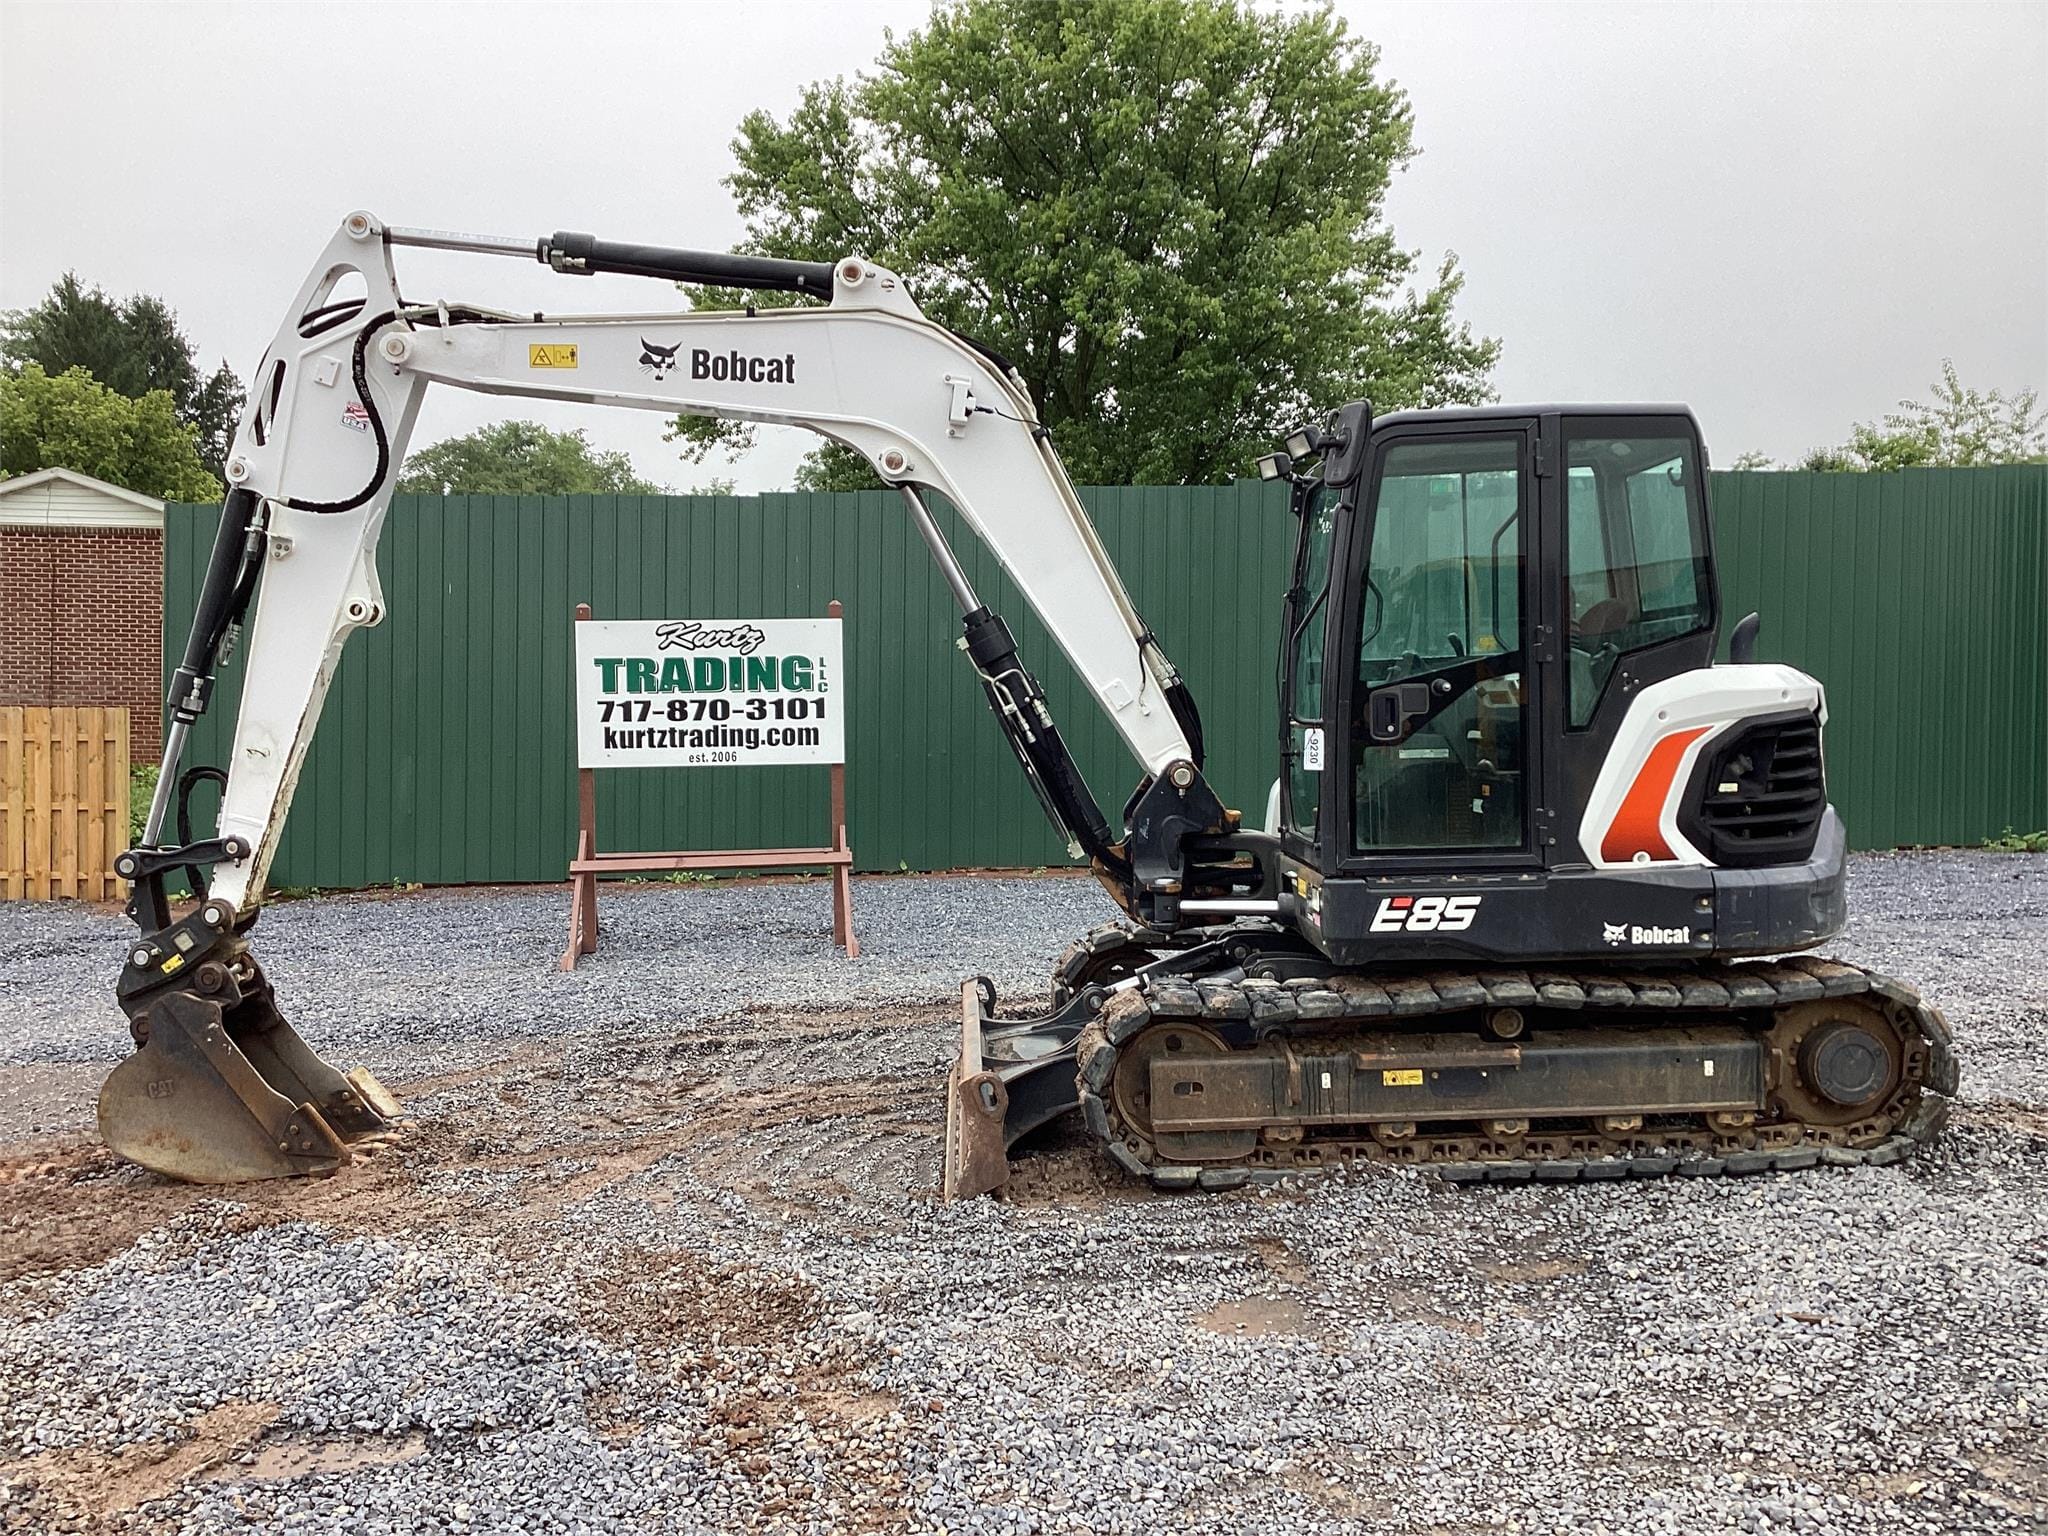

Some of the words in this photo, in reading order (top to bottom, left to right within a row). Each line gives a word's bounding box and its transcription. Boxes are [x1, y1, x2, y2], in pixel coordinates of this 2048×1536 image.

[691, 348, 795, 384] Bobcat
[342, 416, 367, 431] USA
[655, 622, 766, 656] Kurtz
[593, 655, 815, 694] TRADING
[818, 656, 829, 693] LLC
[596, 697, 826, 723] 717-870-3101
[603, 724, 820, 750] kurtztrading.com
[688, 752, 709, 763] est.
[711, 751, 738, 763] 2006
[1309, 738, 1319, 764] 9230
[1368, 895, 1482, 932] E85
[1631, 925, 1690, 945] Bobcat
[148, 1079, 174, 1099] CAT
